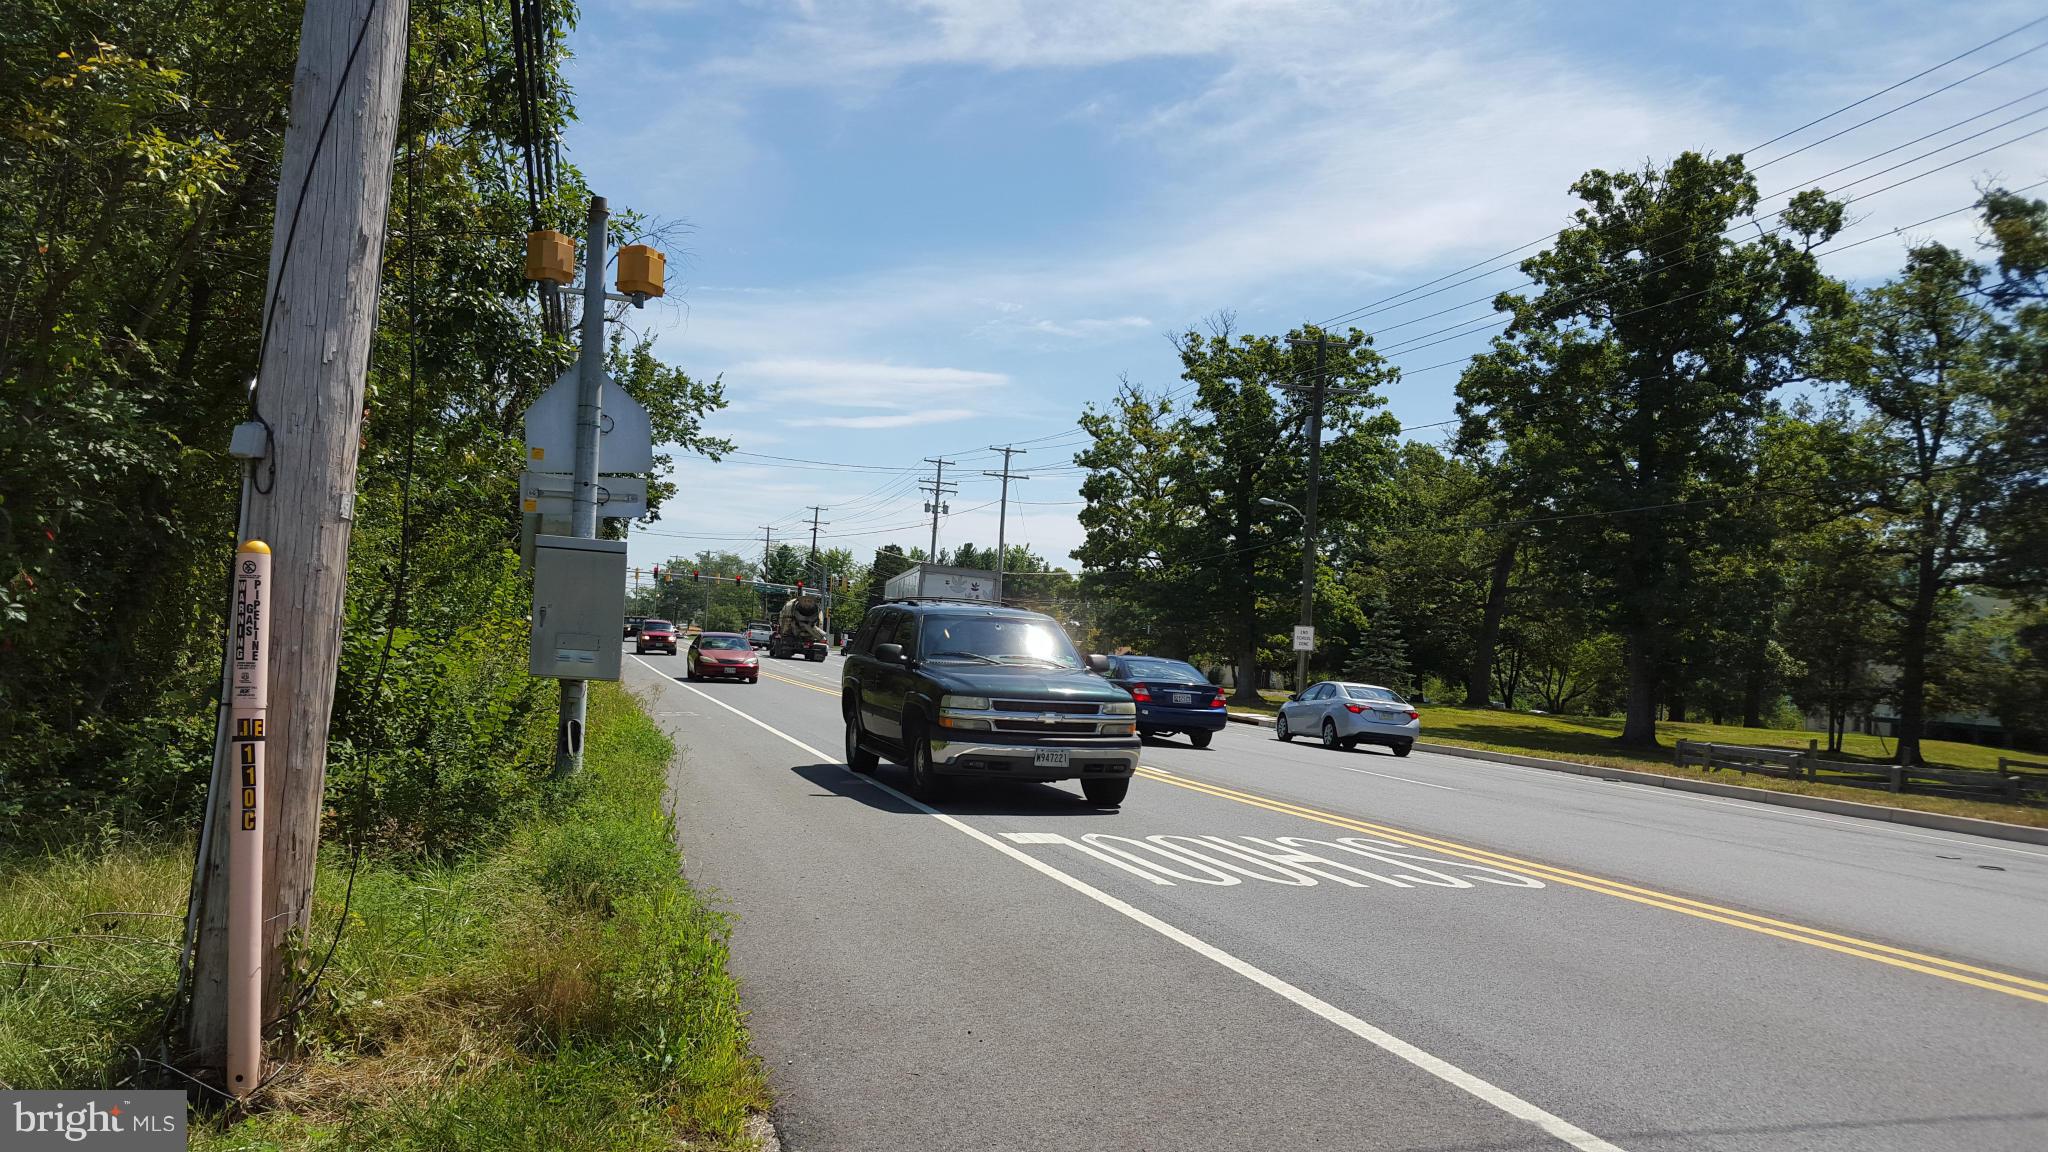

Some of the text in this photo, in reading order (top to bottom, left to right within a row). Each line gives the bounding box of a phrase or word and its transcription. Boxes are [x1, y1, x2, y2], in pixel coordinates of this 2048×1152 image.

[236, 580, 246, 660] WARNING
[246, 604, 254, 636] GAS
[252, 580, 261, 660] PIPELINE
